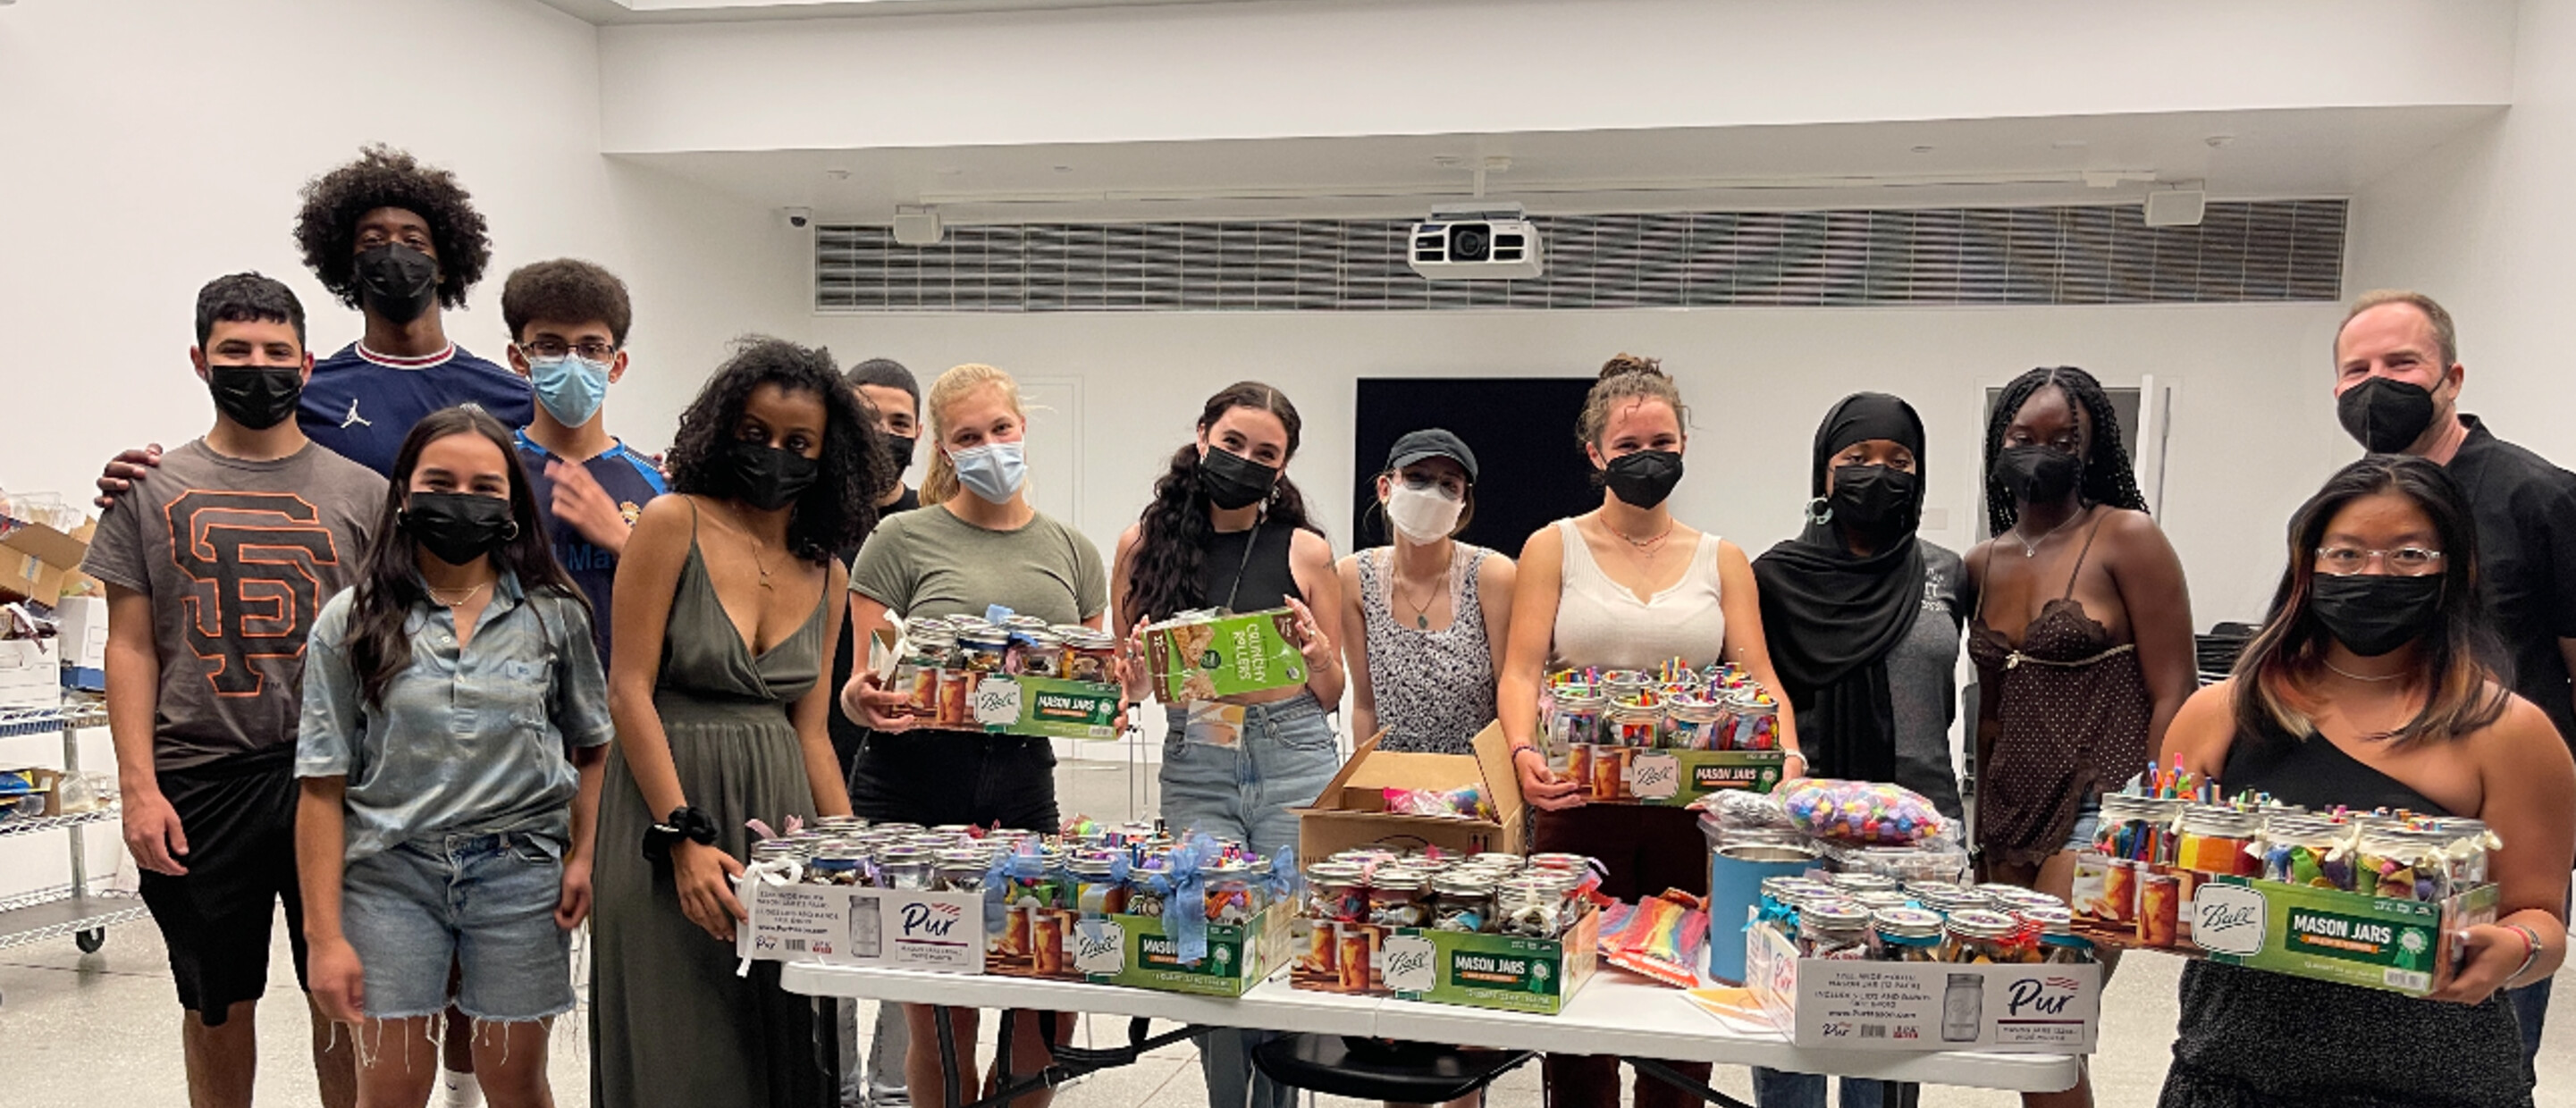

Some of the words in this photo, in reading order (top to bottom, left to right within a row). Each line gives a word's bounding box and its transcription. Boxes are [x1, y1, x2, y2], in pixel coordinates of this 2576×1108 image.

[164, 489, 339, 698] SF
[1038, 696, 1071, 709] MASON
[1696, 768, 1731, 780] MASON
[900, 902, 960, 936] Pur
[2201, 902, 2256, 932] Ball
[2294, 914, 2349, 938] MASON
[2351, 923, 2393, 944] JARS
[1454, 955, 1494, 972] MASON
[1497, 959, 1526, 975] JARS
[2008, 978, 2075, 1016] Pur
